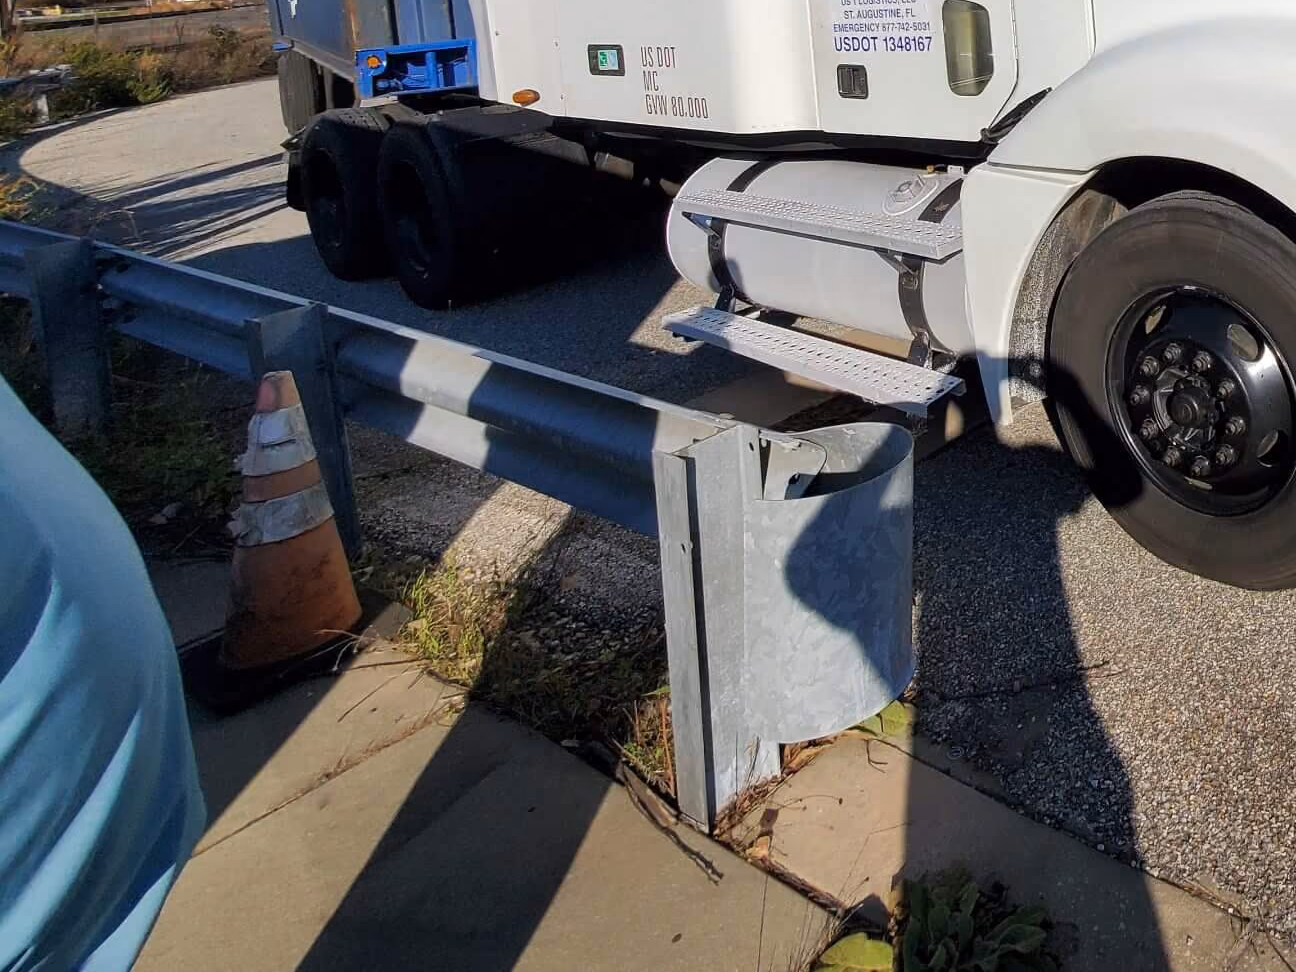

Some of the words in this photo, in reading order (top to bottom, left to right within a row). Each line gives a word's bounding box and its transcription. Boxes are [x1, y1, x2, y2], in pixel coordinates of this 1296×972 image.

[844, 10, 855, 19] ST.
[857, 8, 904, 19] AUGUSTINE,
[905, 8, 916, 18] FL
[833, 23, 880, 33] EMERGENCY
[834, 36, 878, 52] USDOT
[883, 36, 932, 52] 1348167
[640, 46, 655, 68] US
[656, 46, 677, 69] DOT
[643, 70, 660, 92] MC
[645, 94, 669, 116] GVW
